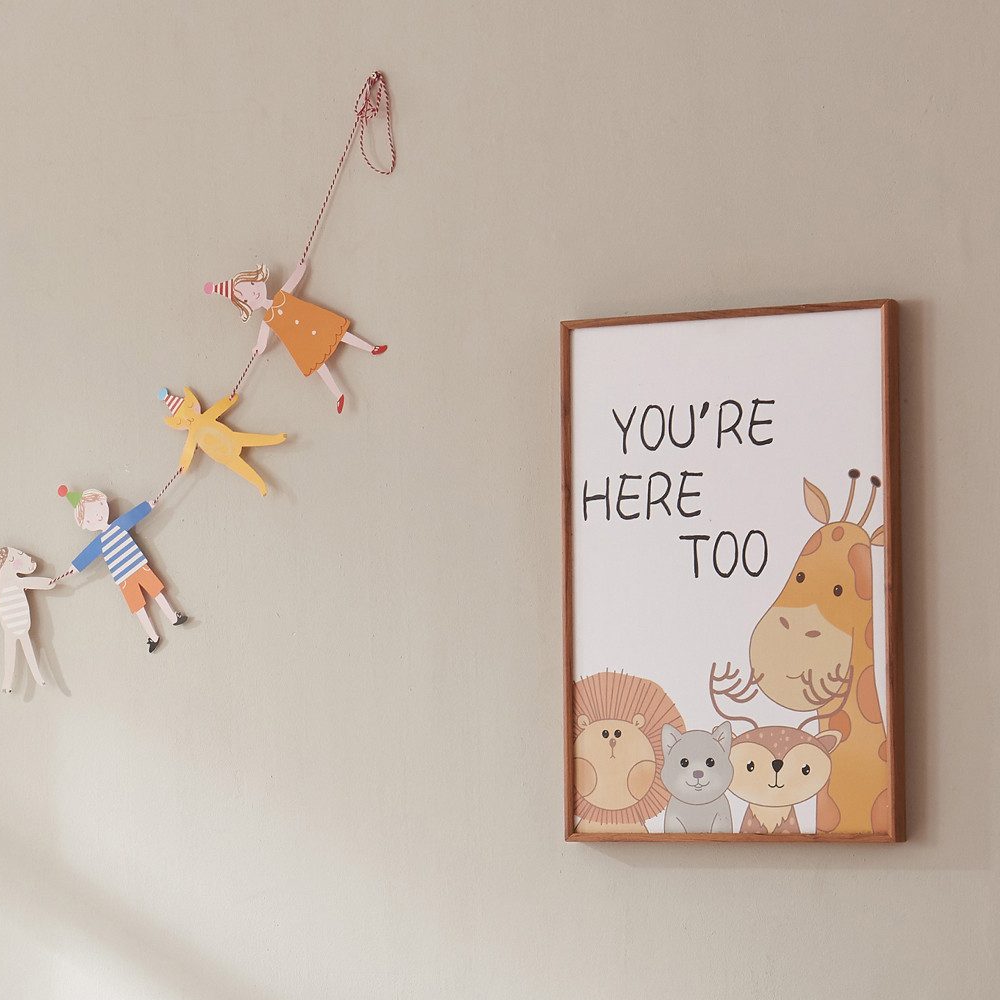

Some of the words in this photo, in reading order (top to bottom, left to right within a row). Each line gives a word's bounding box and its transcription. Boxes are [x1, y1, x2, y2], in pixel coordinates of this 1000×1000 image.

[612, 398, 775, 454] YOU'RE
[582, 471, 703, 521] HERE
[679, 530, 768, 578] TOO
